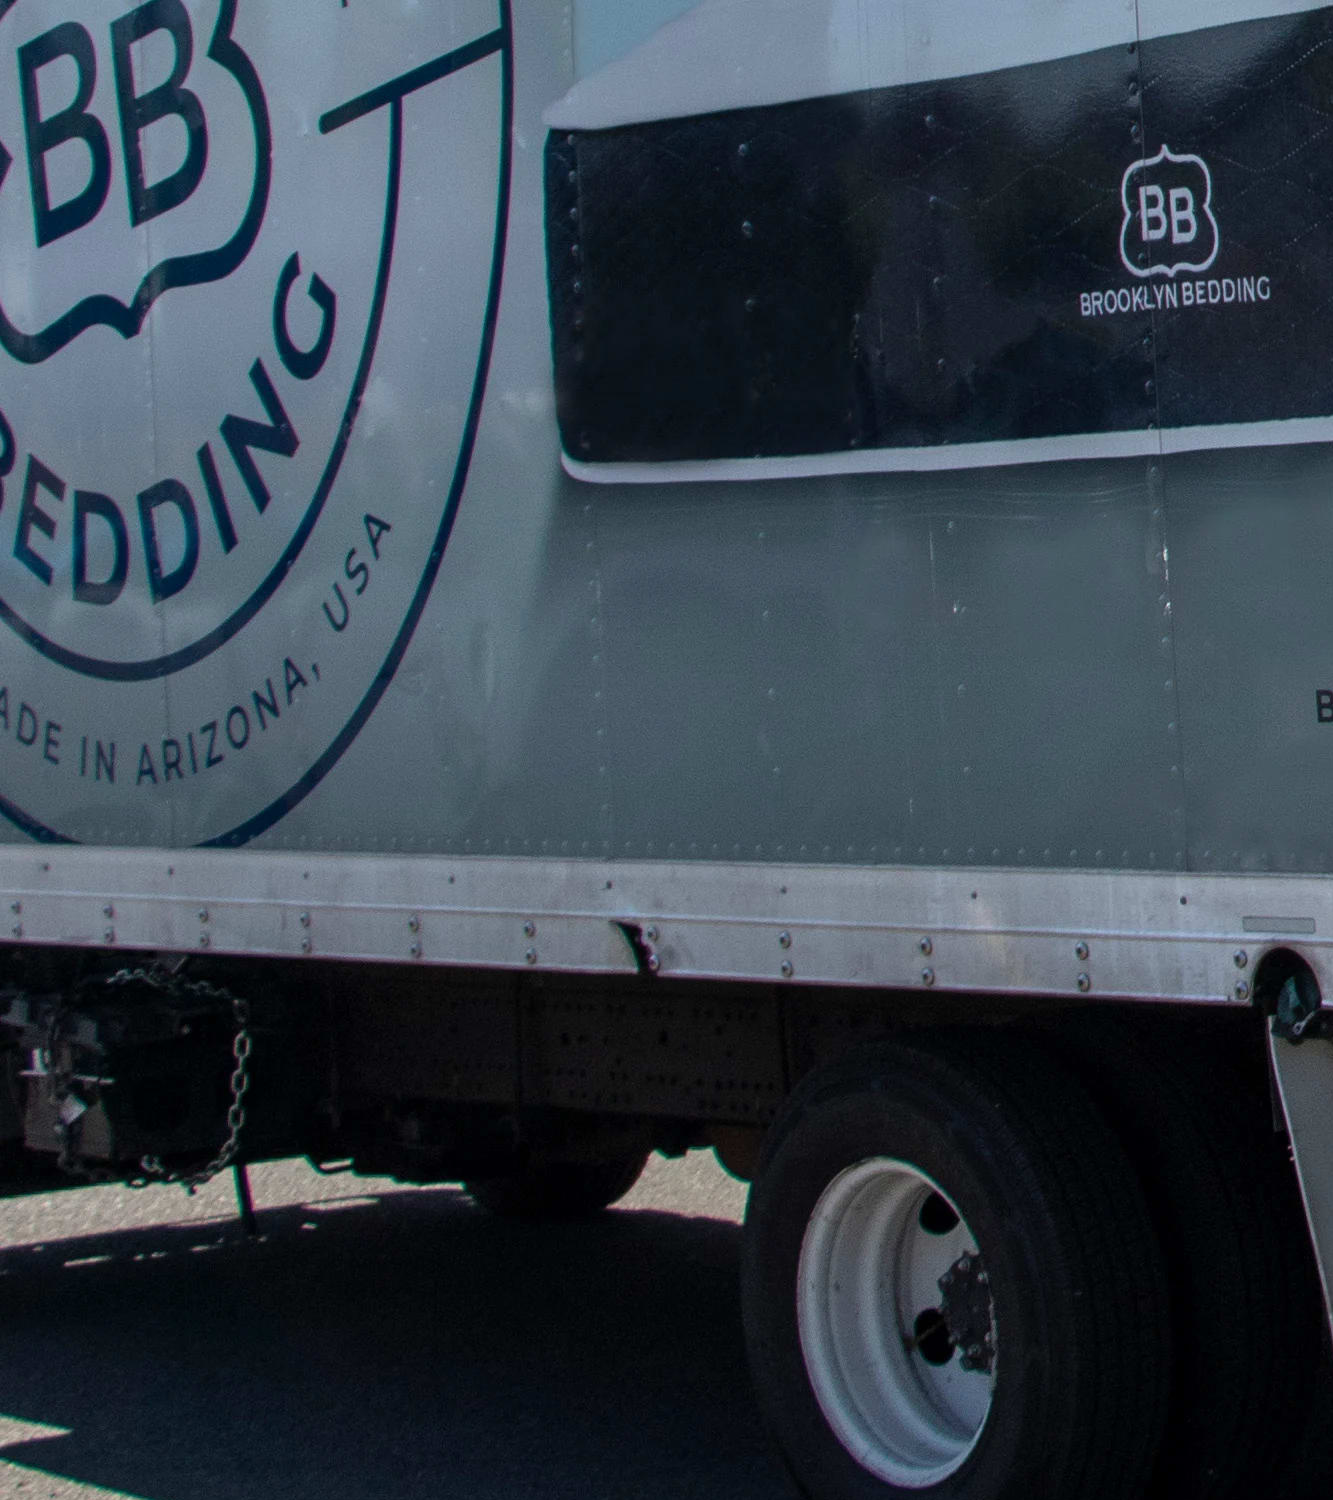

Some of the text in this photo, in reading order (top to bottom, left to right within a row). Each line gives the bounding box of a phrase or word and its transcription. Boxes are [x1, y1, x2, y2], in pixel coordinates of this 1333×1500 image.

[1138, 184, 1198, 245] BB
[1079, 275, 1272, 317] BROOKLYN BEDDING
[80, 736, 117, 786] IN
[136, 656, 321, 786] ARIZONA,
[321, 512, 393, 633] USA
